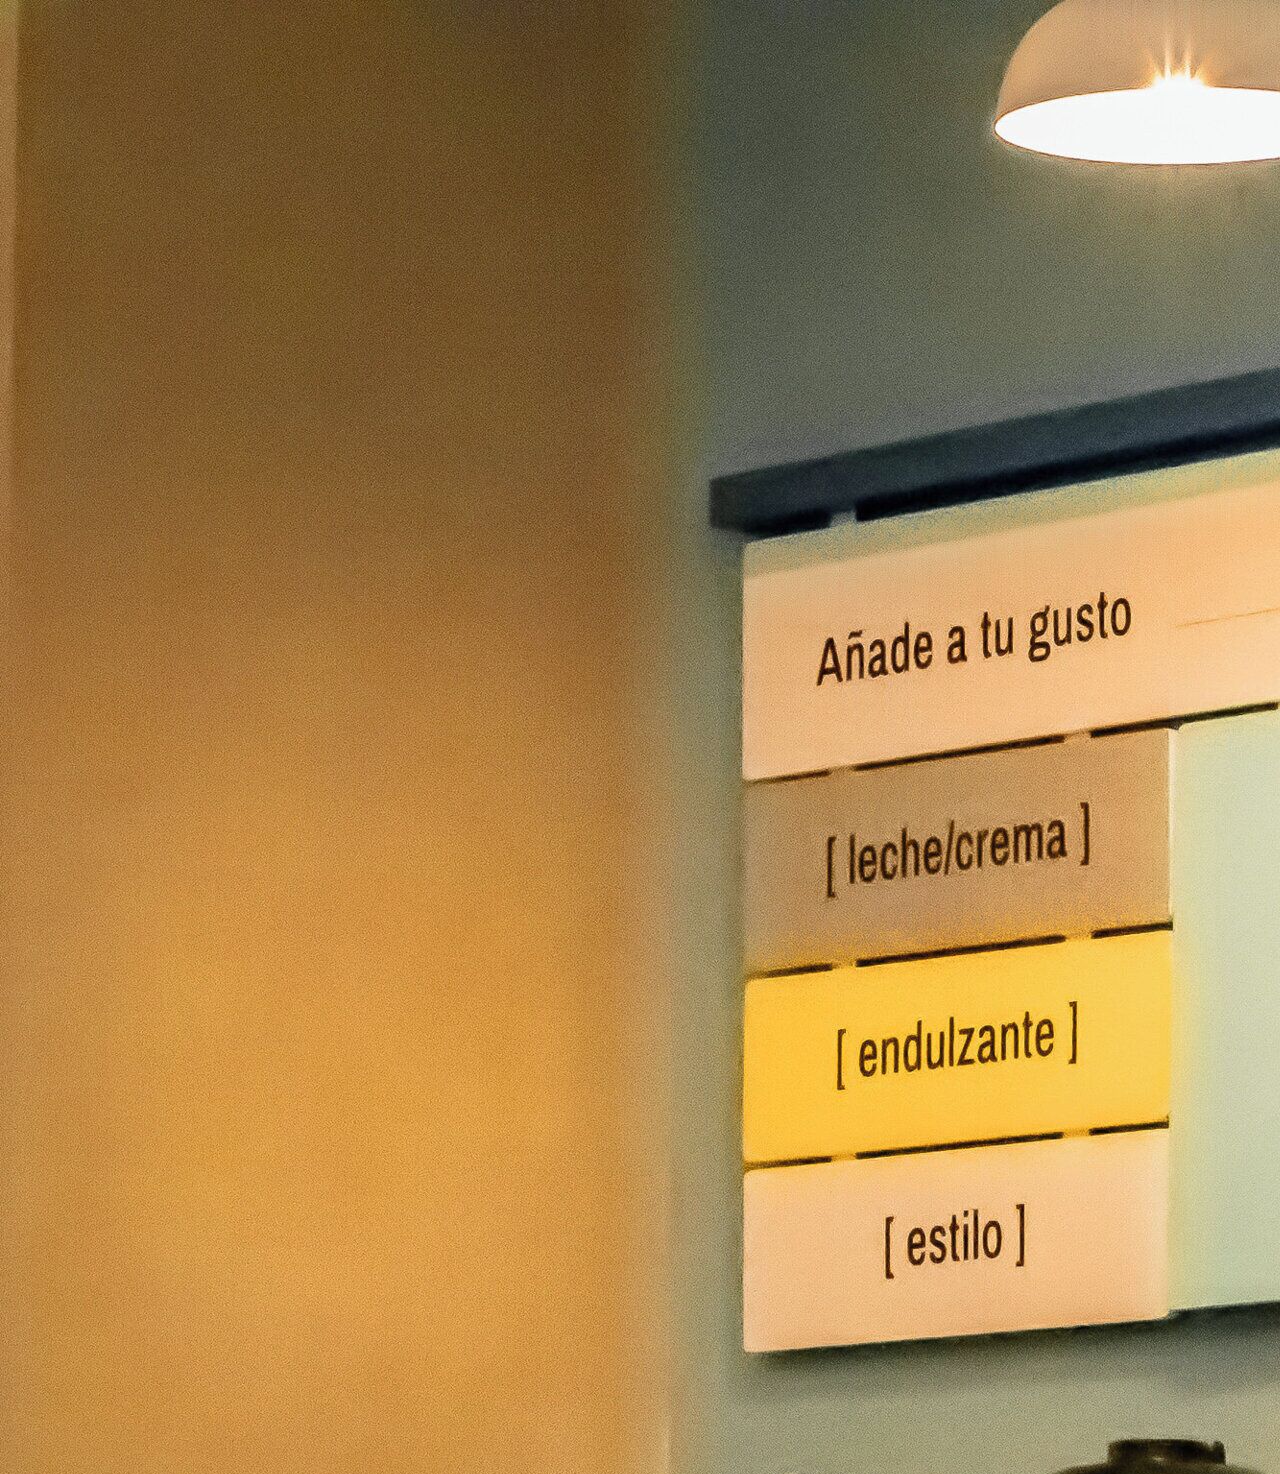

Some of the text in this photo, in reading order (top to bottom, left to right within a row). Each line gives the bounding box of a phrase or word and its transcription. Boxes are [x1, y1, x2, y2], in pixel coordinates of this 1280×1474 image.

[816, 591, 1132, 687] Añade a tu gusto
